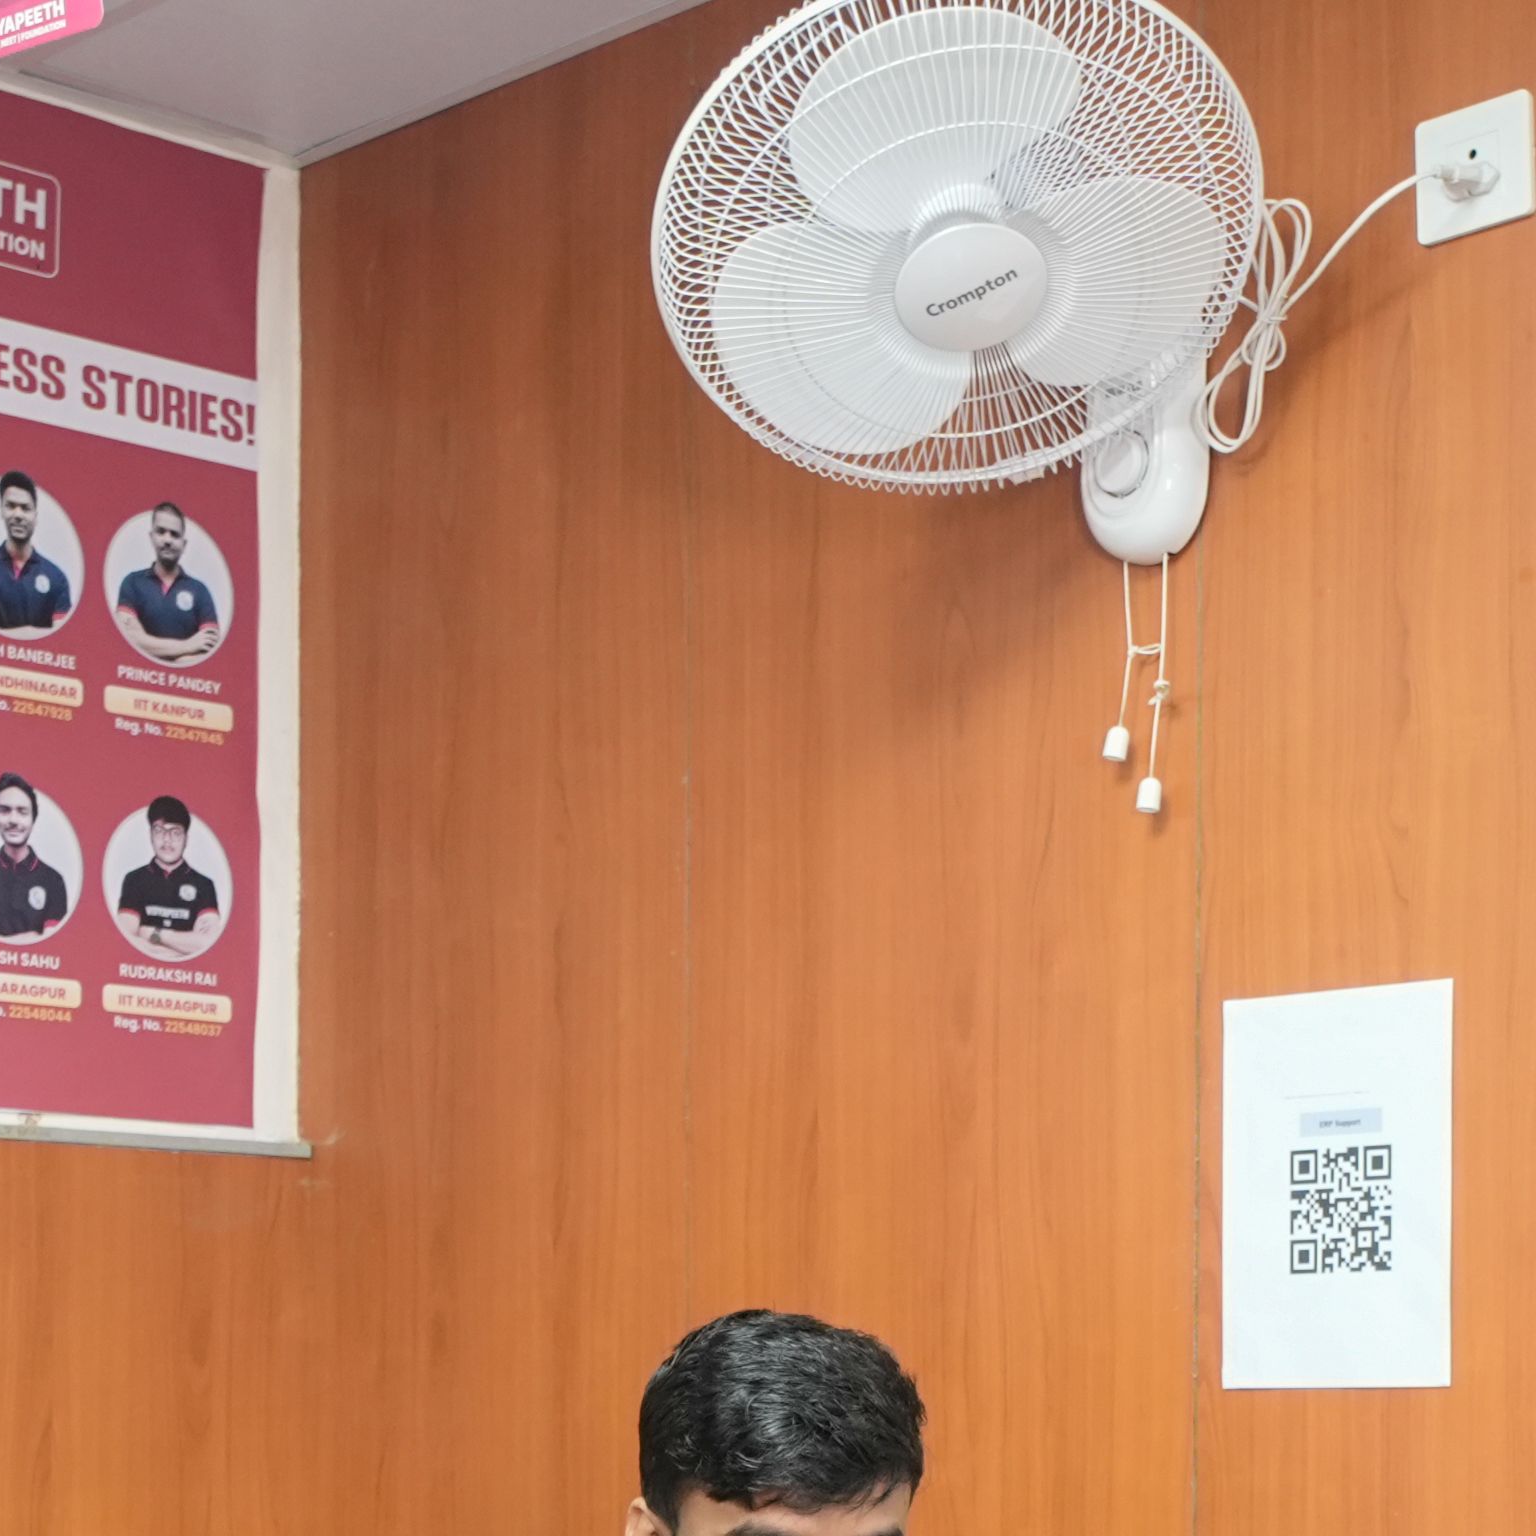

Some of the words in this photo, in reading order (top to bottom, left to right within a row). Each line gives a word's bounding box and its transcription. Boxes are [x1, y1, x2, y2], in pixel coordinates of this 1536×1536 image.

[925, 267, 1018, 317] Crompton
[82, 365, 255, 446] STORIES!
[7, 645, 76, 670] BANERJEE
[117, 665, 166, 686] PRINCE
[168, 674, 221, 694] PANDEY
[134, 698, 149, 711] IIT
[152, 701, 205, 720] KANPUR
[144, 722, 163, 736] No.
[20, 952, 61, 970] SAHU
[119, 963, 192, 984] RUDRAKSH
[194, 972, 218, 987] RAI
[119, 994, 133, 1006] IIT
[137, 995, 218, 1015] KHARAGPUR
[114, 1015, 140, 1033] Reg.
[143, 1019, 162, 1032] No.
